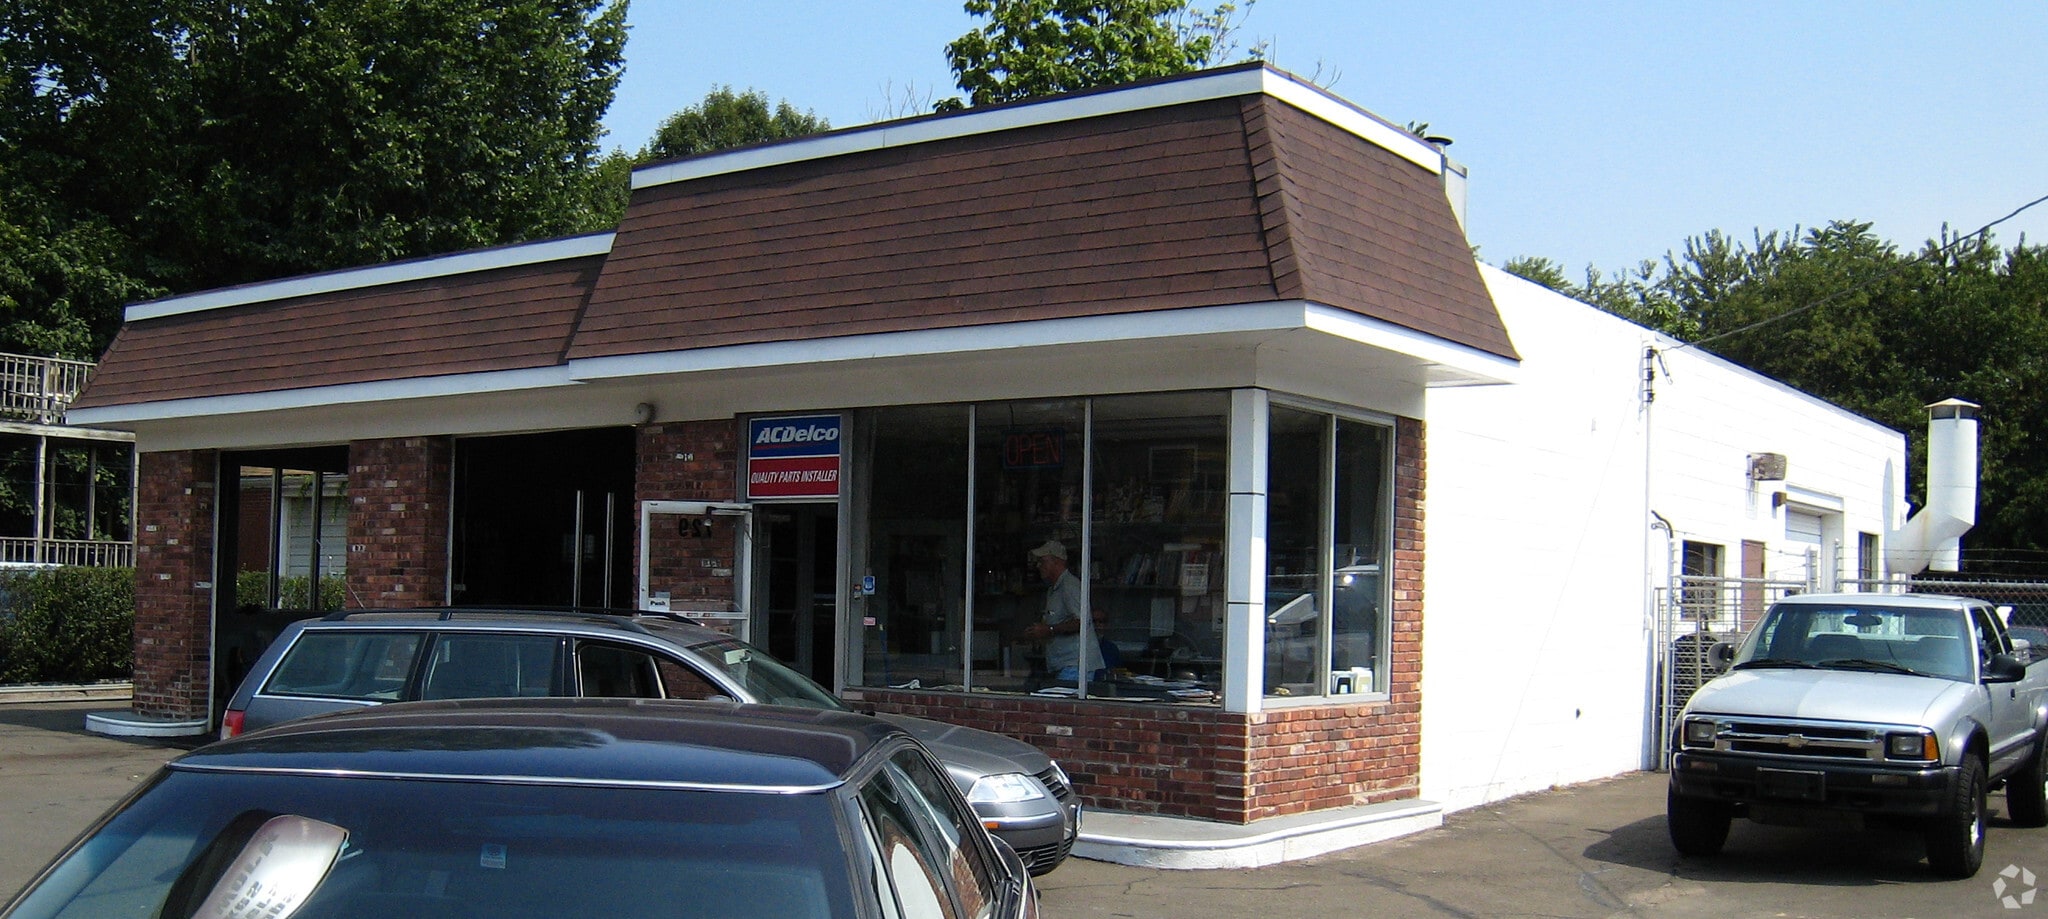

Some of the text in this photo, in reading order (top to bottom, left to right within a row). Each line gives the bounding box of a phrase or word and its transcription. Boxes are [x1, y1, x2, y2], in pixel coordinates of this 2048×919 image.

[756, 425, 839, 444] ACDelco
[1006, 433, 1060, 465] OPEN
[751, 469, 838, 484] QUALITY PARTS INSTALLER
